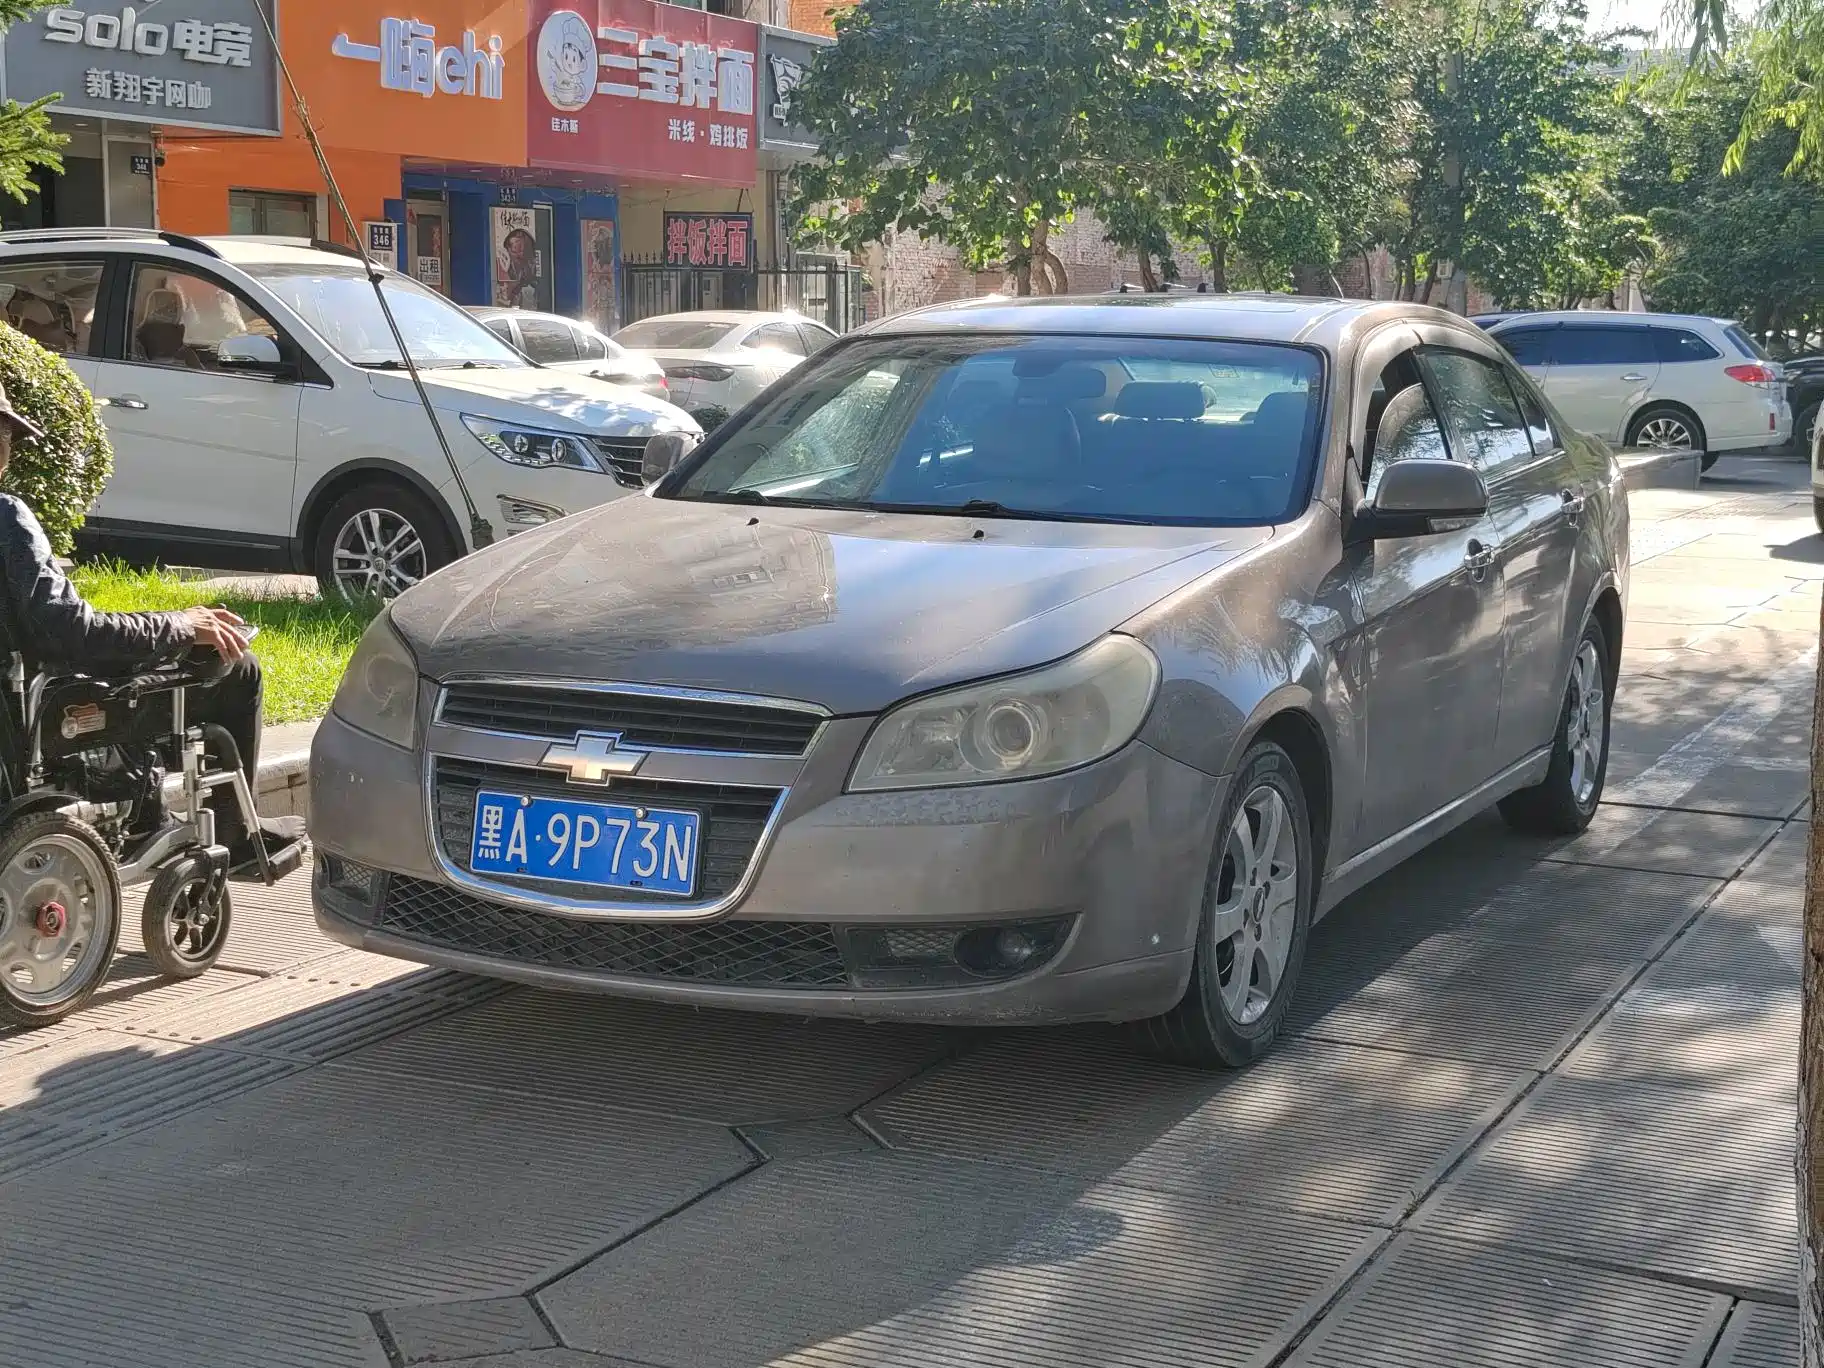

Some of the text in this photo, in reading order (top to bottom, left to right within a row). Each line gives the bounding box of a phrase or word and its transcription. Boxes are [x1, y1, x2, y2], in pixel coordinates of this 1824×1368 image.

[85, 67, 212, 109] 新翔宇网咖
[597, 27, 754, 115] 三宝拌面
[551, 117, 579, 136] 佳木斯
[374, 234, 390, 246] 346
[667, 218, 748, 266] 拌饭拌面
[419, 258, 439, 273] 出租
[478, 805, 692, 882] 黑A·9P73N
